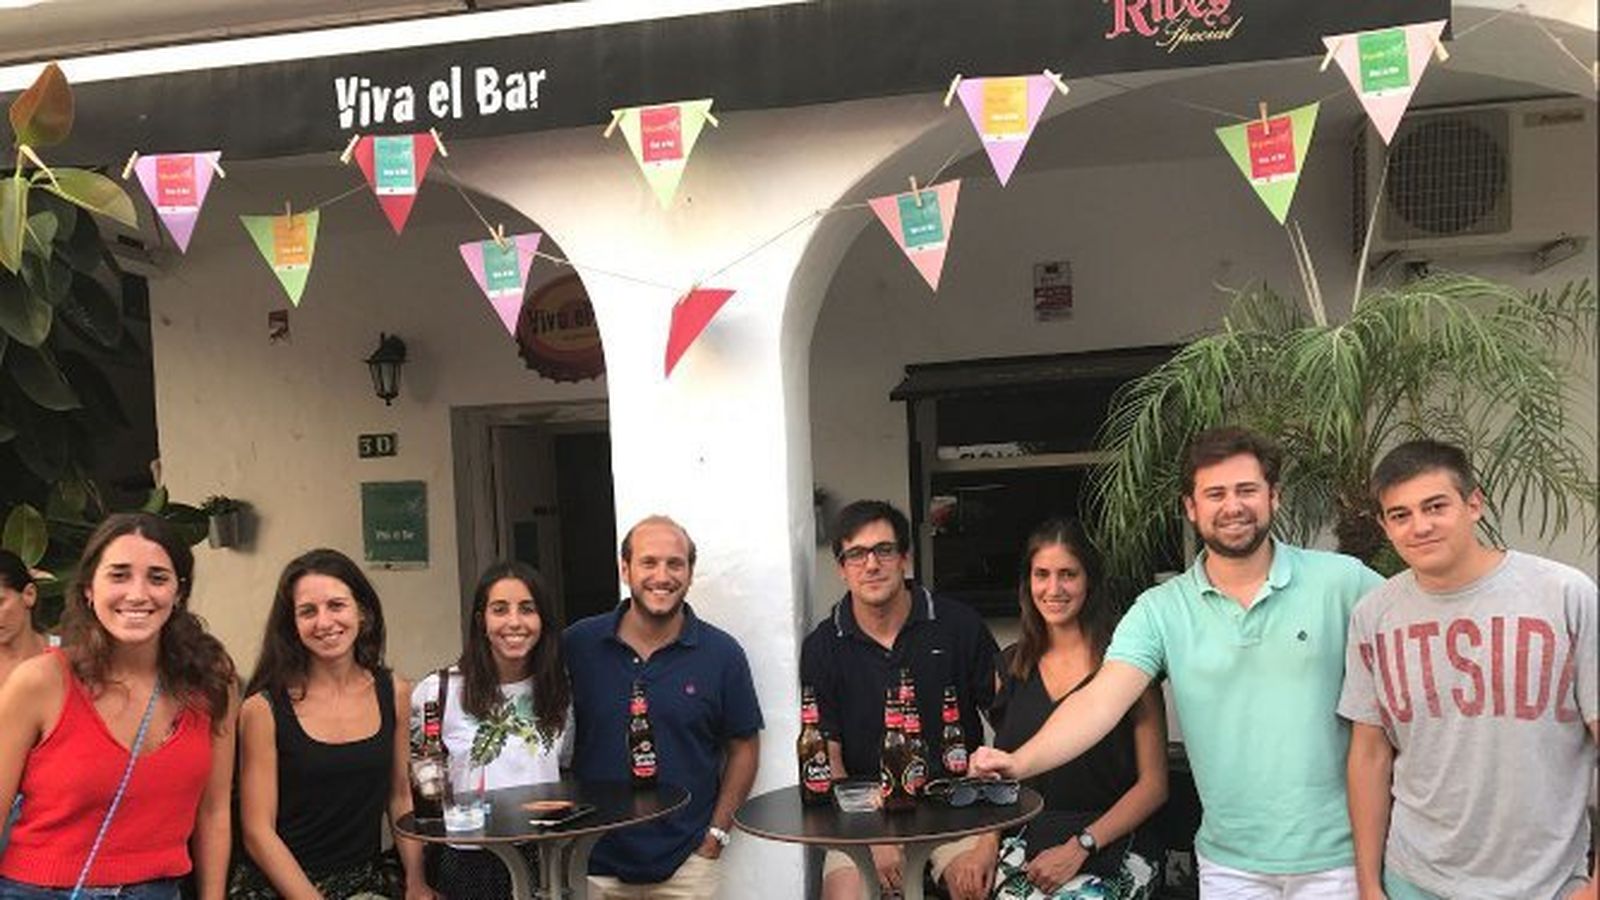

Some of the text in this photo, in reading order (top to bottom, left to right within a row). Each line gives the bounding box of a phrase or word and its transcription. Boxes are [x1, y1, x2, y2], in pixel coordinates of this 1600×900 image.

[1155, 16, 1244, 53] Special
[334, 66, 546, 129] Viva el Bar
